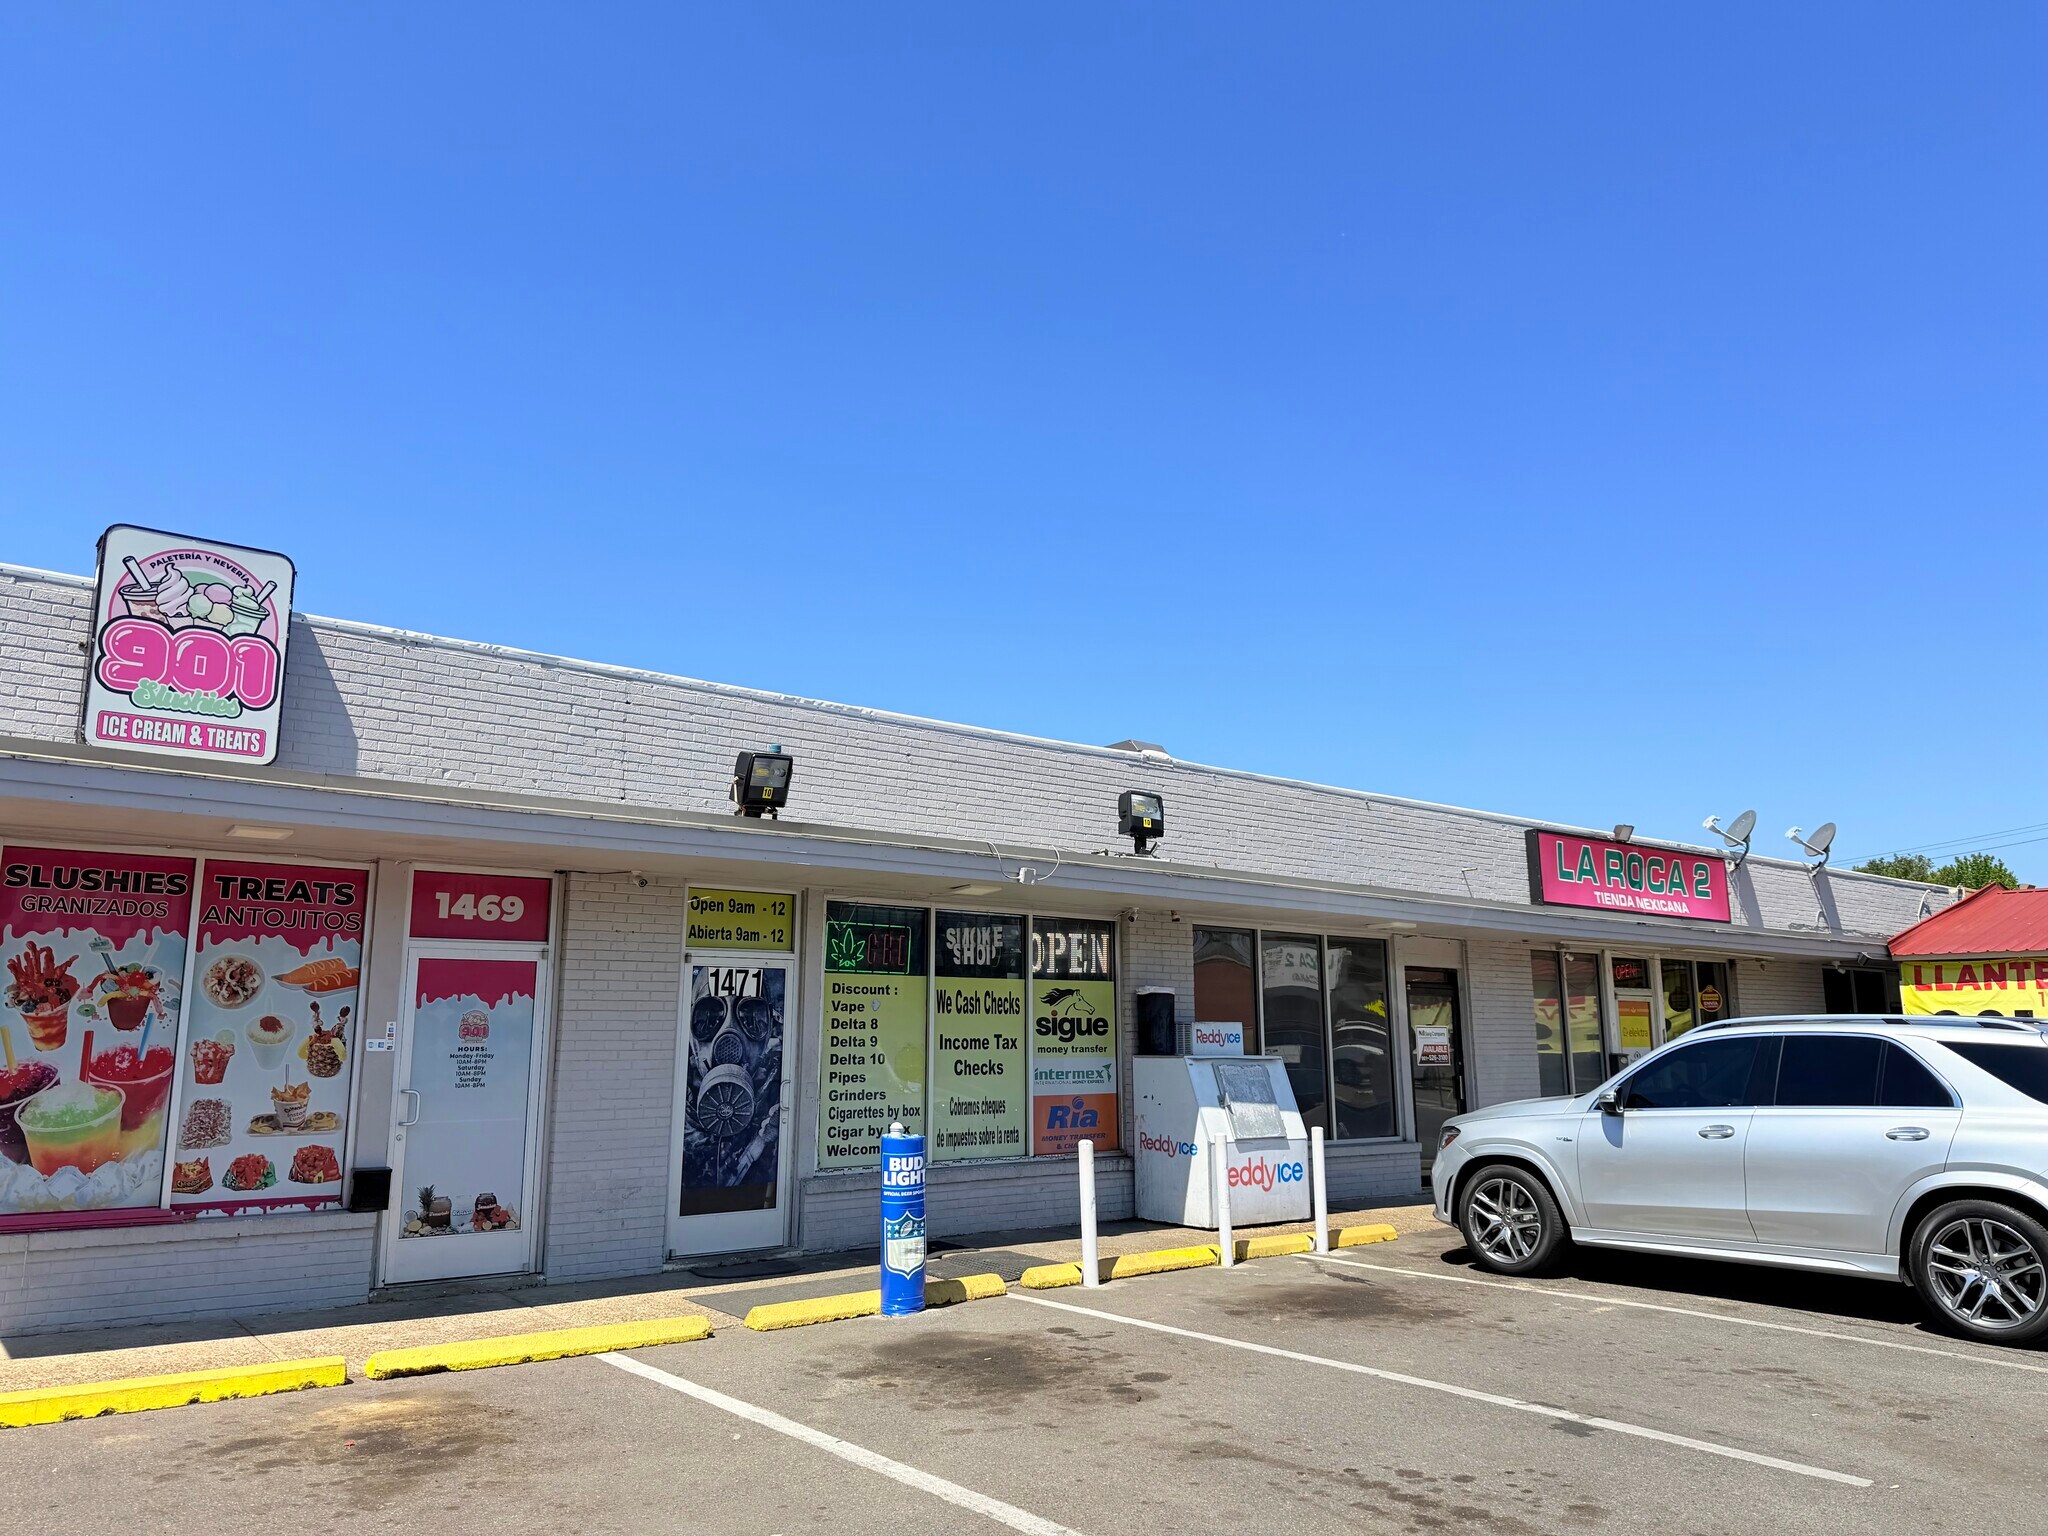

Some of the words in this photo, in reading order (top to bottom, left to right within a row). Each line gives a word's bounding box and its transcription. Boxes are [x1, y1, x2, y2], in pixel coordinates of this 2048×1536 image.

[149, 551, 202, 570] PALETERÍA
[212, 557, 250, 584] NEVERÍA
[97, 620, 278, 709] 901
[102, 715, 128, 737] ICE
[132, 718, 186, 744] CREAM
[189, 725, 203, 747] &
[207, 728, 261, 752] TREATS
[764, 788, 773, 797] 10
[1556, 840, 1600, 885] LA
[1605, 848, 1689, 897] ROCA
[1693, 862, 1712, 899] 2
[4, 864, 188, 896] SLUSHIES
[214, 875, 356, 906] TREATS
[1594, 891, 1637, 909] TIENDA
[20, 895, 169, 918] GRANIZADOS
[435, 892, 525, 923] 1469
[690, 896, 724, 915] Open
[728, 898, 755, 914] 9am
[771, 901, 785, 916] 12
[201, 905, 362, 932] ANTOJITOS
[688, 924, 732, 940] Abierta
[736, 927, 760, 942] 9am
[771, 929, 784, 943] 12
[946, 926, 1003, 950] SMOKE
[953, 943, 996, 966] SHOP
[1032, 932, 1110, 974] OPEN
[1616, 964, 1638, 979] OPEN
[709, 969, 763, 997] 1471
[832, 983, 890, 996] Discount
[831, 1001, 865, 1013] Vape
[936, 989, 952, 1014] We
[955, 990, 980, 1014] Cash
[984, 991, 1020, 1015] Checks
[831, 1018, 866, 1031] Delta
[870, 1018, 878, 1030] 8
[1036, 1010, 1108, 1043] sigue
[1629, 1026, 1648, 1038] elektra
[830, 1035, 866, 1048] Delta
[870, 1036, 878, 1048] 9
[939, 1034, 989, 1050] Income
[994, 1034, 1018, 1050] Tax
[1037, 1046, 1068, 1056] money
[1071, 1045, 1108, 1054] transfer
[829, 1053, 866, 1066] Delta
[871, 1053, 886, 1065] 10
[954, 1059, 1004, 1076] Checks
[829, 1071, 866, 1084] Pipes
[1034, 1068, 1104, 1081] intermex
[829, 1089, 886, 1101] Grinders
[828, 1105, 884, 1123] Cigarettes
[887, 1104, 899, 1120] by
[902, 1104, 920, 1117] box
[950, 1097, 980, 1116] Cobramos
[981, 1096, 1006, 1119] cheques
[1047, 1096, 1098, 1129] Ria
[827, 1126, 864, 1140] Cigar
[868, 1125, 883, 1139] by
[936, 1128, 945, 1148] de
[946, 1127, 977, 1151] impuestos
[979, 1126, 995, 1146] sobre
[996, 1126, 1003, 1144] la
[1003, 1126, 1020, 1144] renta
[1041, 1134, 1067, 1142] MONEY
[826, 1144, 881, 1157] Welcom
[889, 1156, 923, 1171] BUD
[1228, 1156, 1303, 1192] eddyice
